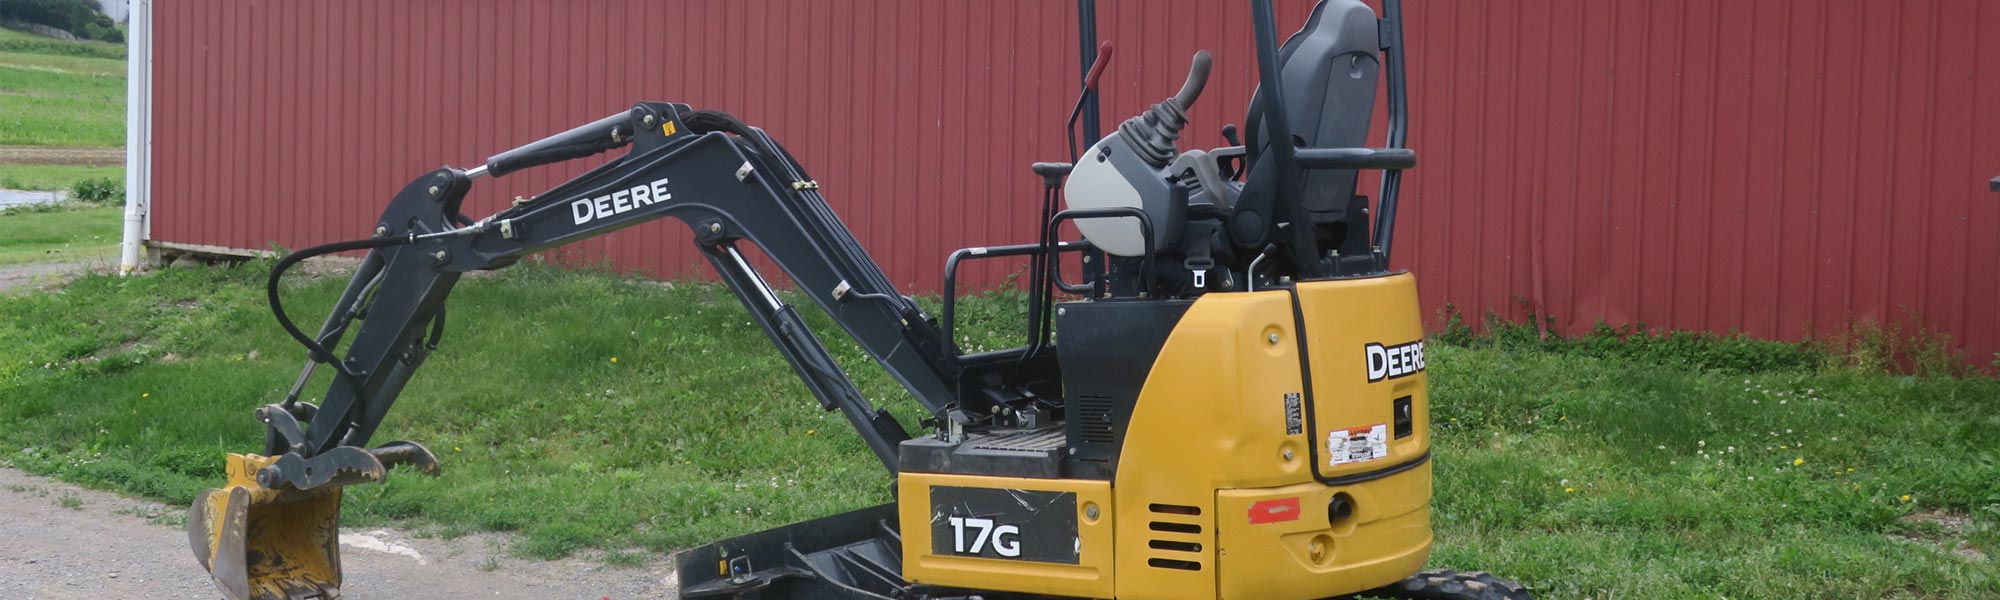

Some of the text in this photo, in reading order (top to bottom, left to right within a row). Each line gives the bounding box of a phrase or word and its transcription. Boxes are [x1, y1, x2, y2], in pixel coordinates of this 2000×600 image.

[571, 178, 672, 225] DEERE
[1366, 341, 1425, 380] DEERE
[951, 517, 1020, 557] 17G
